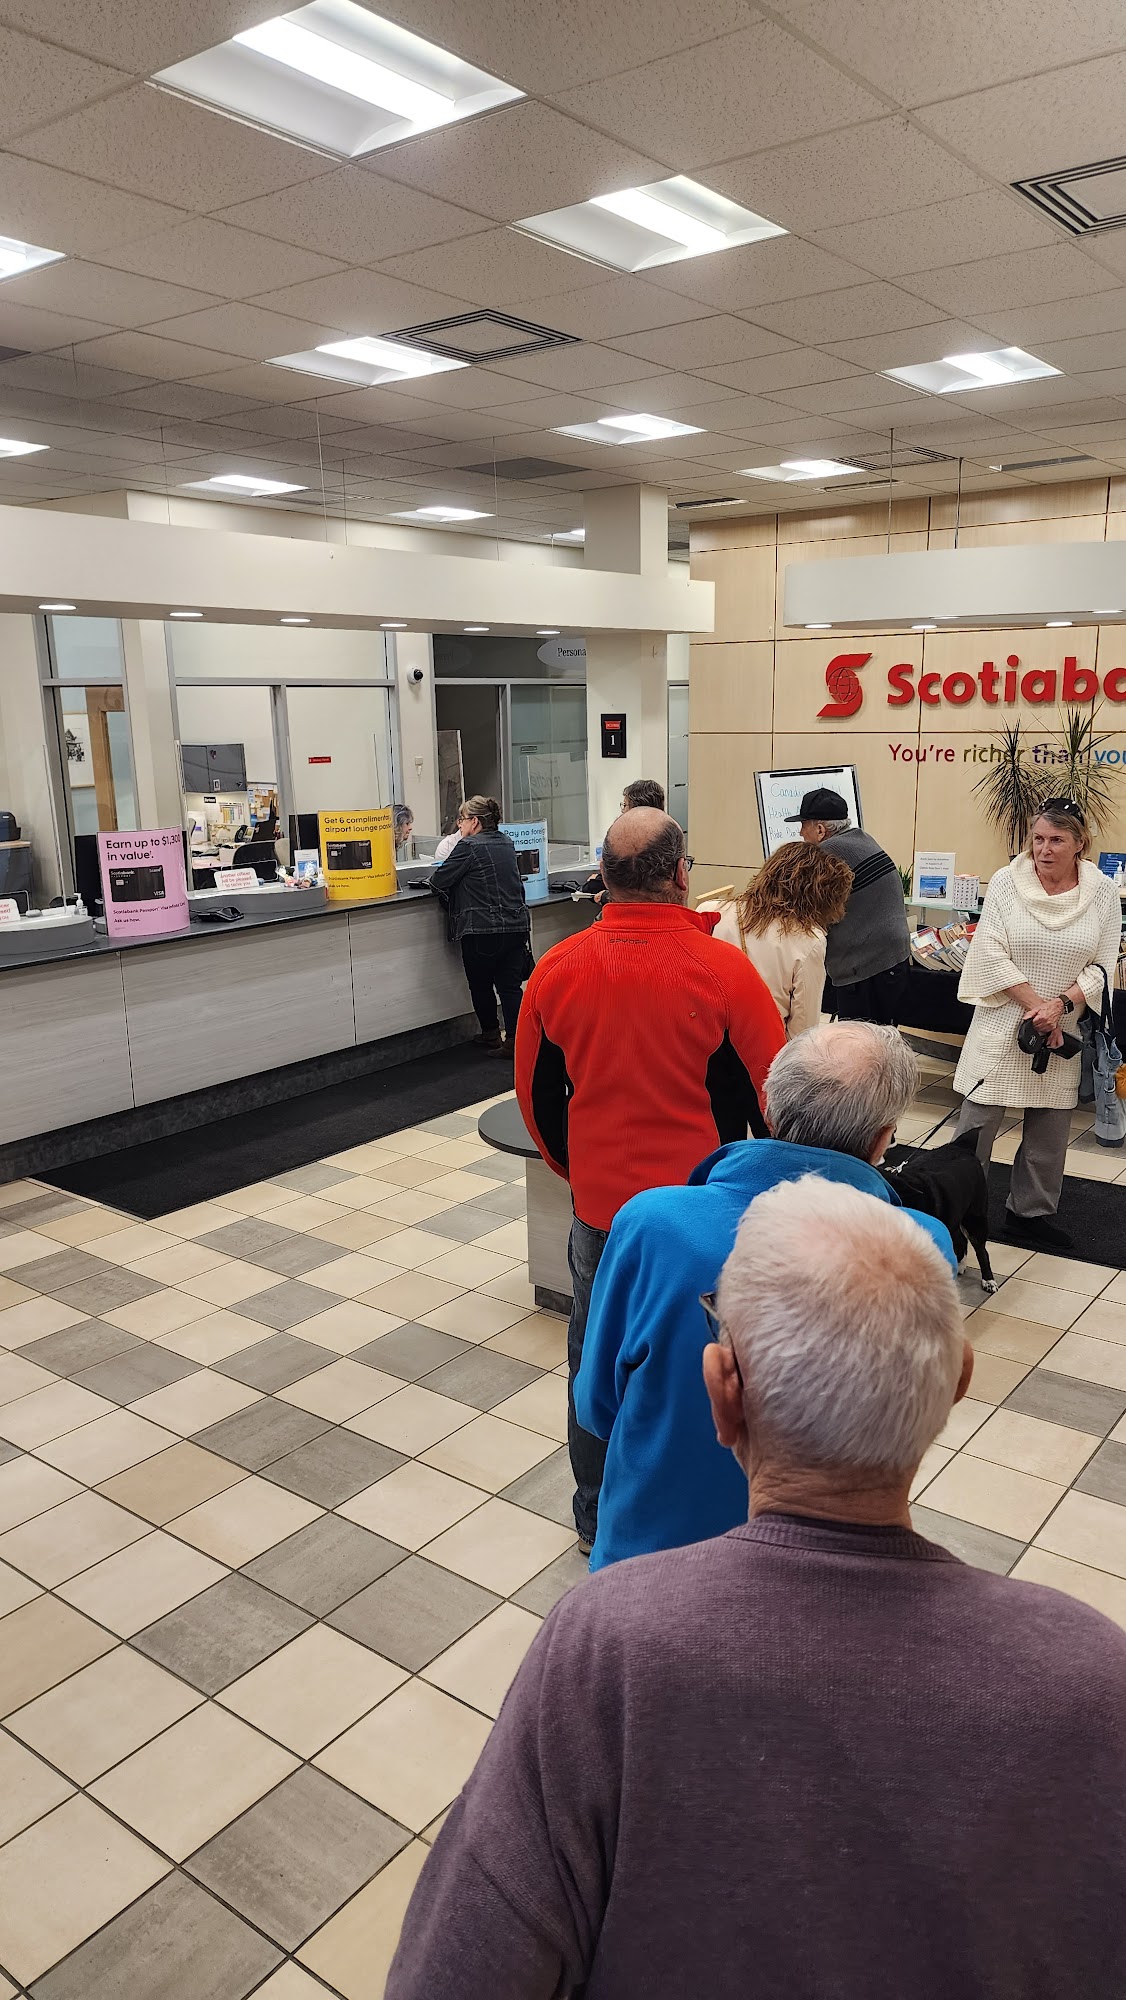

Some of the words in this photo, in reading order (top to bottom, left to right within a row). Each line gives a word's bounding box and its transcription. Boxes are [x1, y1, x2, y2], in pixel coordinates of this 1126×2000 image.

[610, 735, 616, 746] 1
[888, 744, 956, 763] You're
[1094, 750, 1126, 768] yo
[771, 783, 809, 797] Canadia
[325, 826, 351, 834] airport
[106, 840, 132, 849] Earn
[134, 840, 148, 849] up
[107, 852, 118, 861] in
